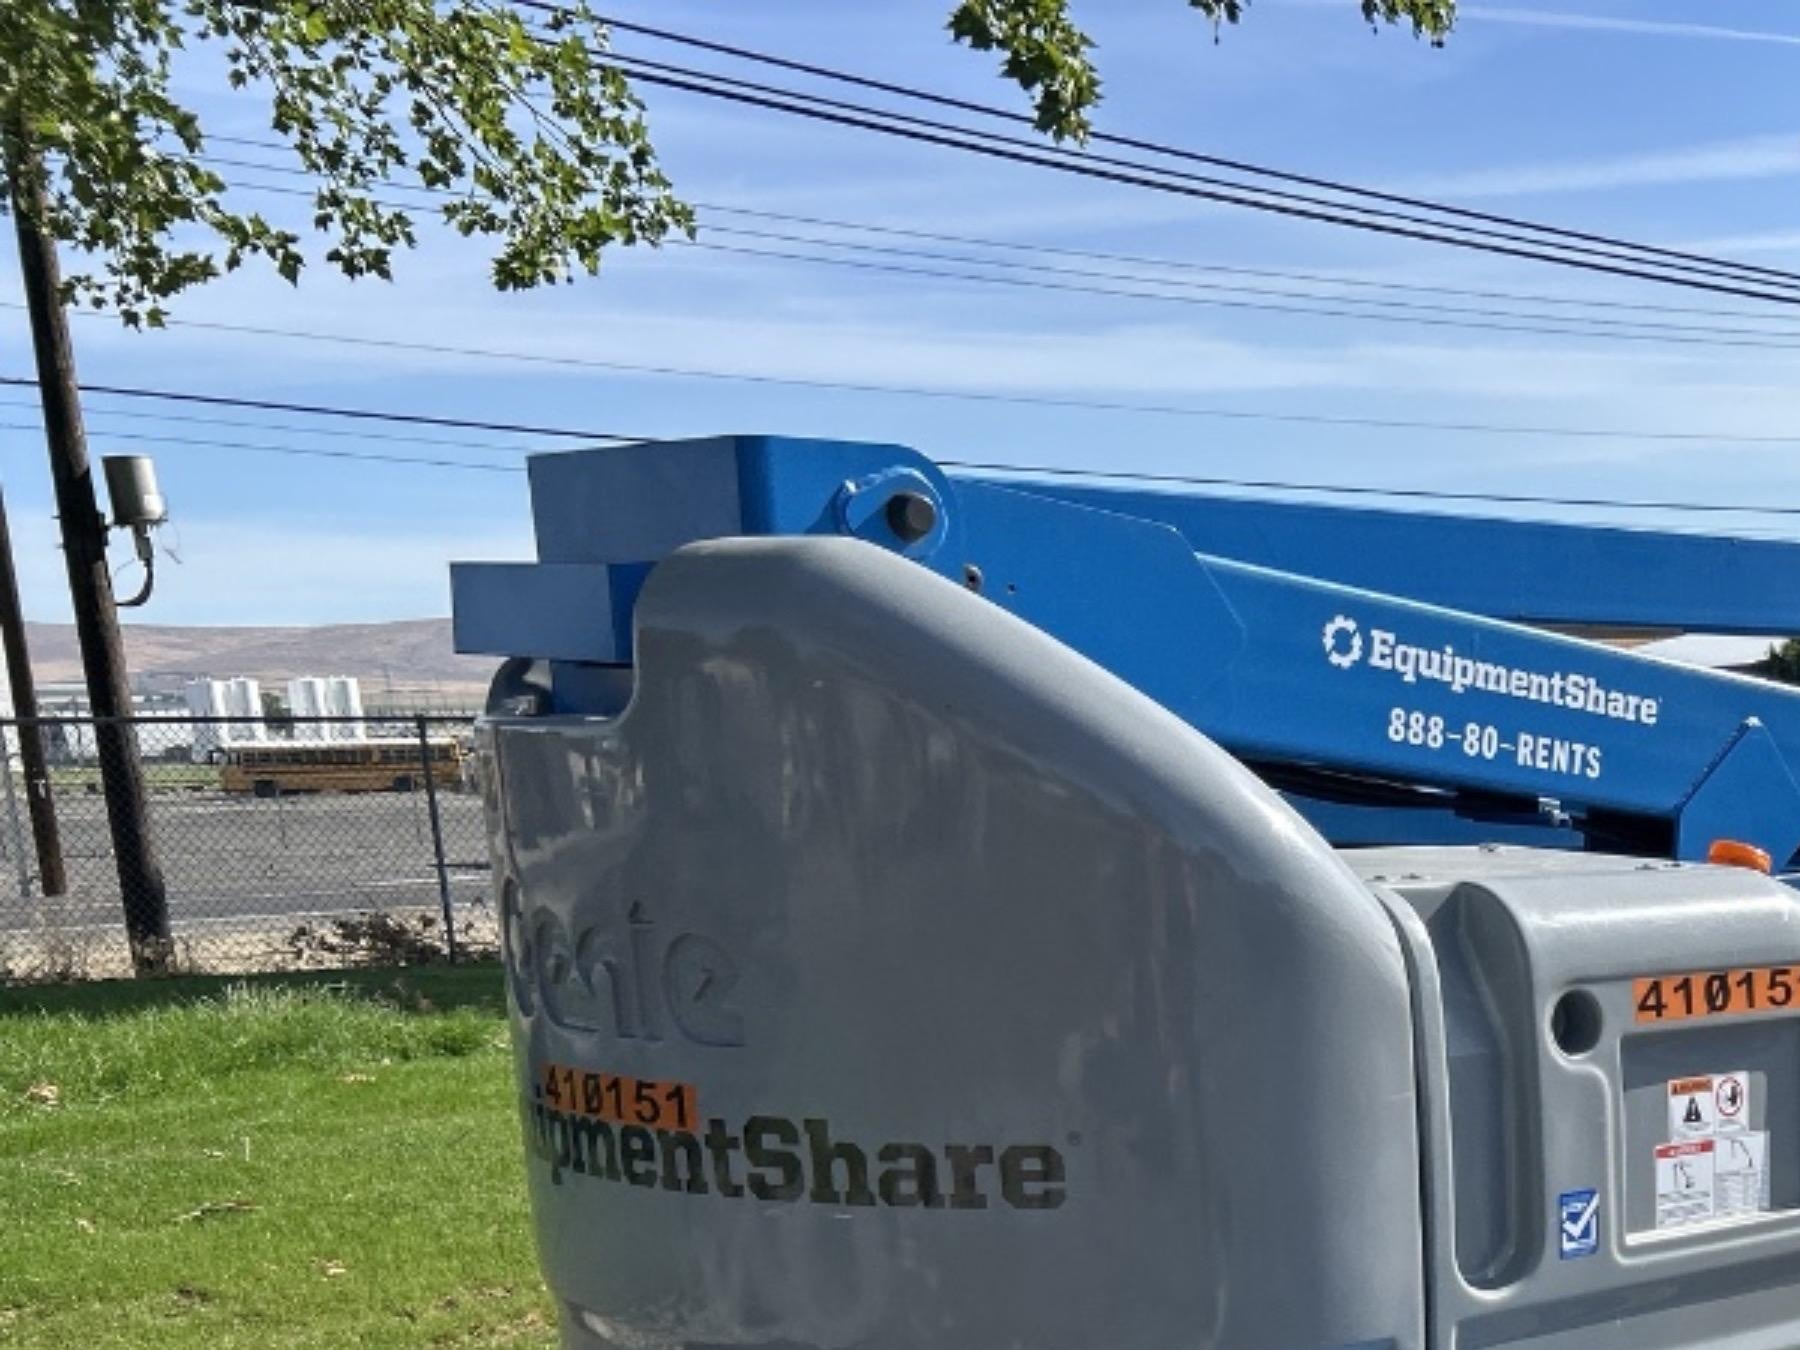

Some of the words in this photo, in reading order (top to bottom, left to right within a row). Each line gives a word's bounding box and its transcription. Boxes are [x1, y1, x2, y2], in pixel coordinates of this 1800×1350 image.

[1367, 628, 1659, 726] EquipmentShare
[1387, 706, 1603, 779] 888-80-RENTS
[544, 1063, 688, 1128] 410151
